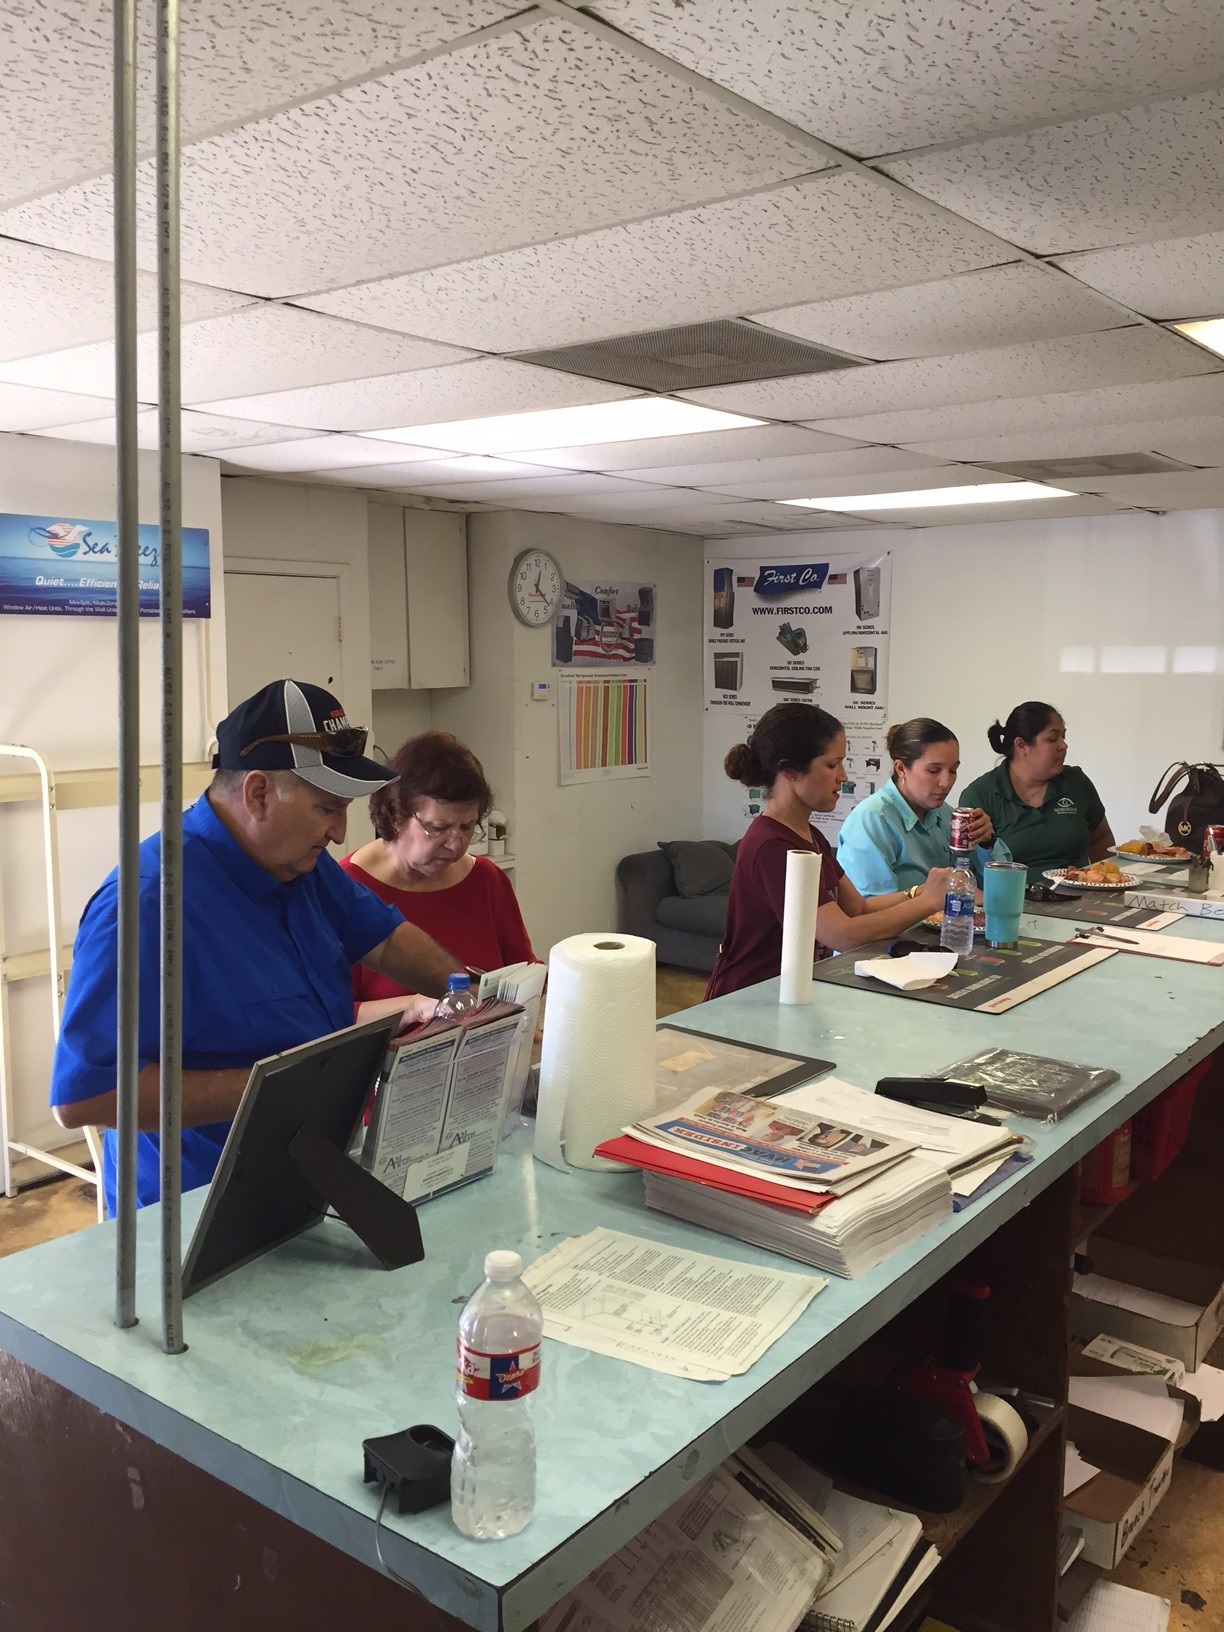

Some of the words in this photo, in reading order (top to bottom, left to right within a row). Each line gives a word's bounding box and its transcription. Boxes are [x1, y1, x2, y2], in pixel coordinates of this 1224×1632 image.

[82, 531, 111, 556] Sea
[764, 570, 797, 586] First
[799, 568, 819, 585] Co.
[752, 606, 833, 616] WWW.FIRSTCO.COM
[1128, 895, 1189, 912] Match
[674, 1127, 743, 1150] INSIDER
[740, 1146, 791, 1164] HVAC
